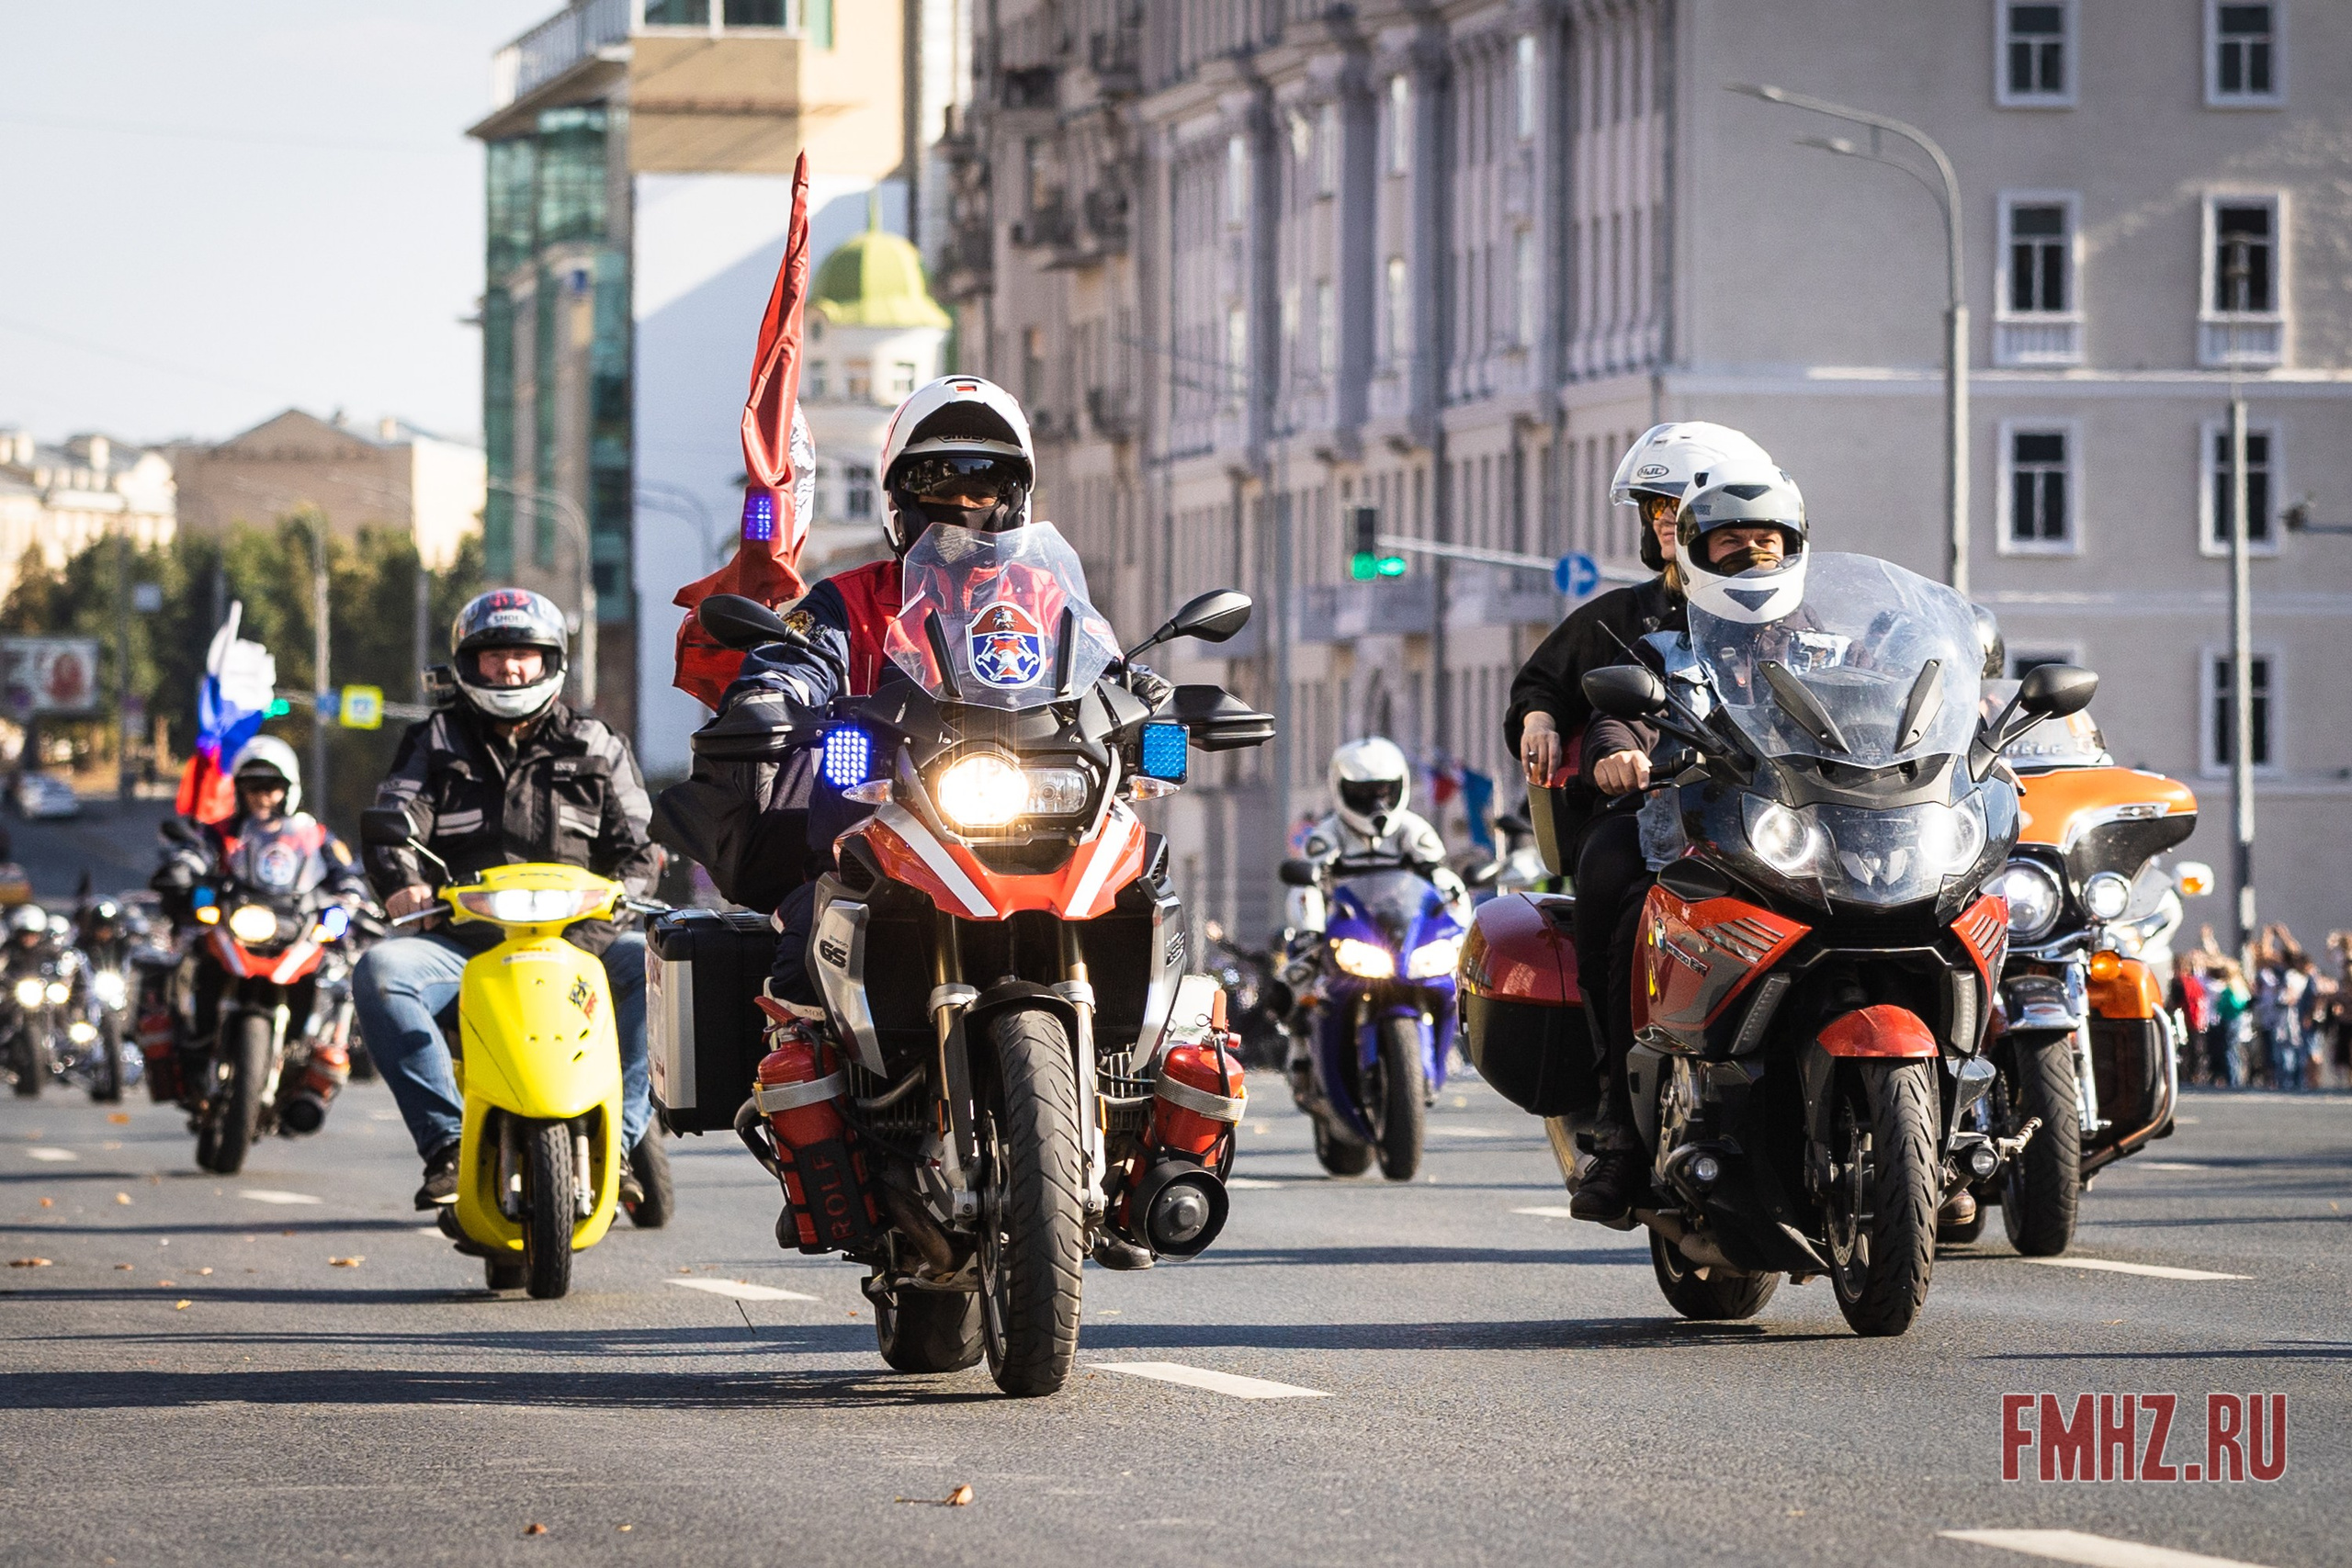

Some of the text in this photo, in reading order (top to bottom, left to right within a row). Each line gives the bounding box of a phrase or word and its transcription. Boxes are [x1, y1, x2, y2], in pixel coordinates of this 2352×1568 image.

[1639, 467, 1666, 476] HJC
[820, 938, 847, 969] GS
[810, 1154, 857, 1241] ROLF
